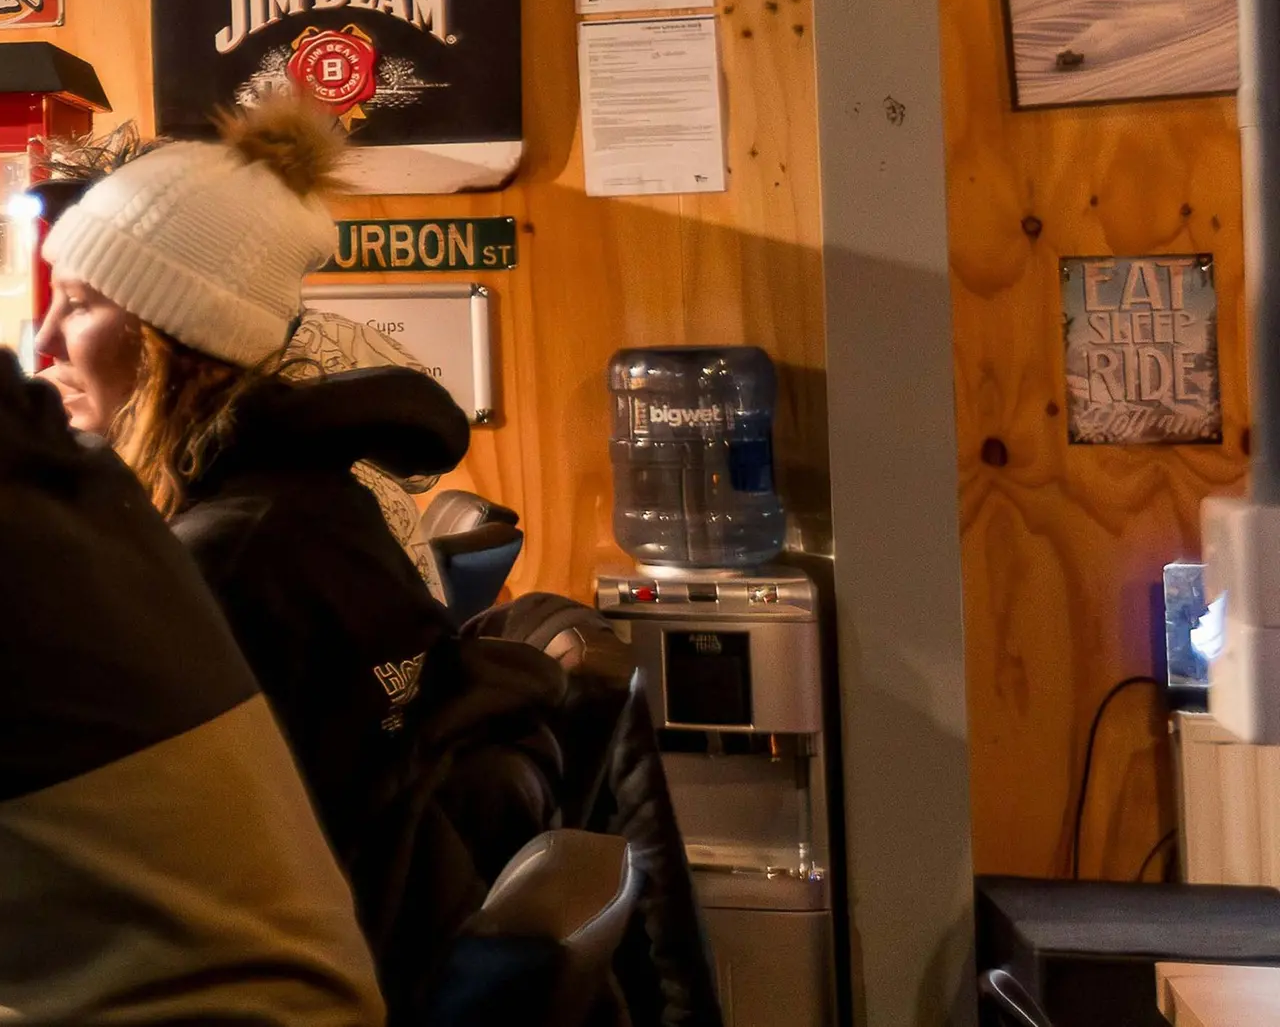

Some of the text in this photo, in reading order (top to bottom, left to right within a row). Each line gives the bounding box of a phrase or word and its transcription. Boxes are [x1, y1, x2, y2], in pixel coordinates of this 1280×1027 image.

[307, 44, 360, 65] JIM BEAM
[322, 58, 342, 81] B
[334, 223, 511, 268] URBON ST
[1083, 260, 1191, 312] EAT
[1088, 313, 1191, 345] SLEEP
[1085, 347, 1198, 402] RIDE
[650, 405, 723, 427] bigwet
